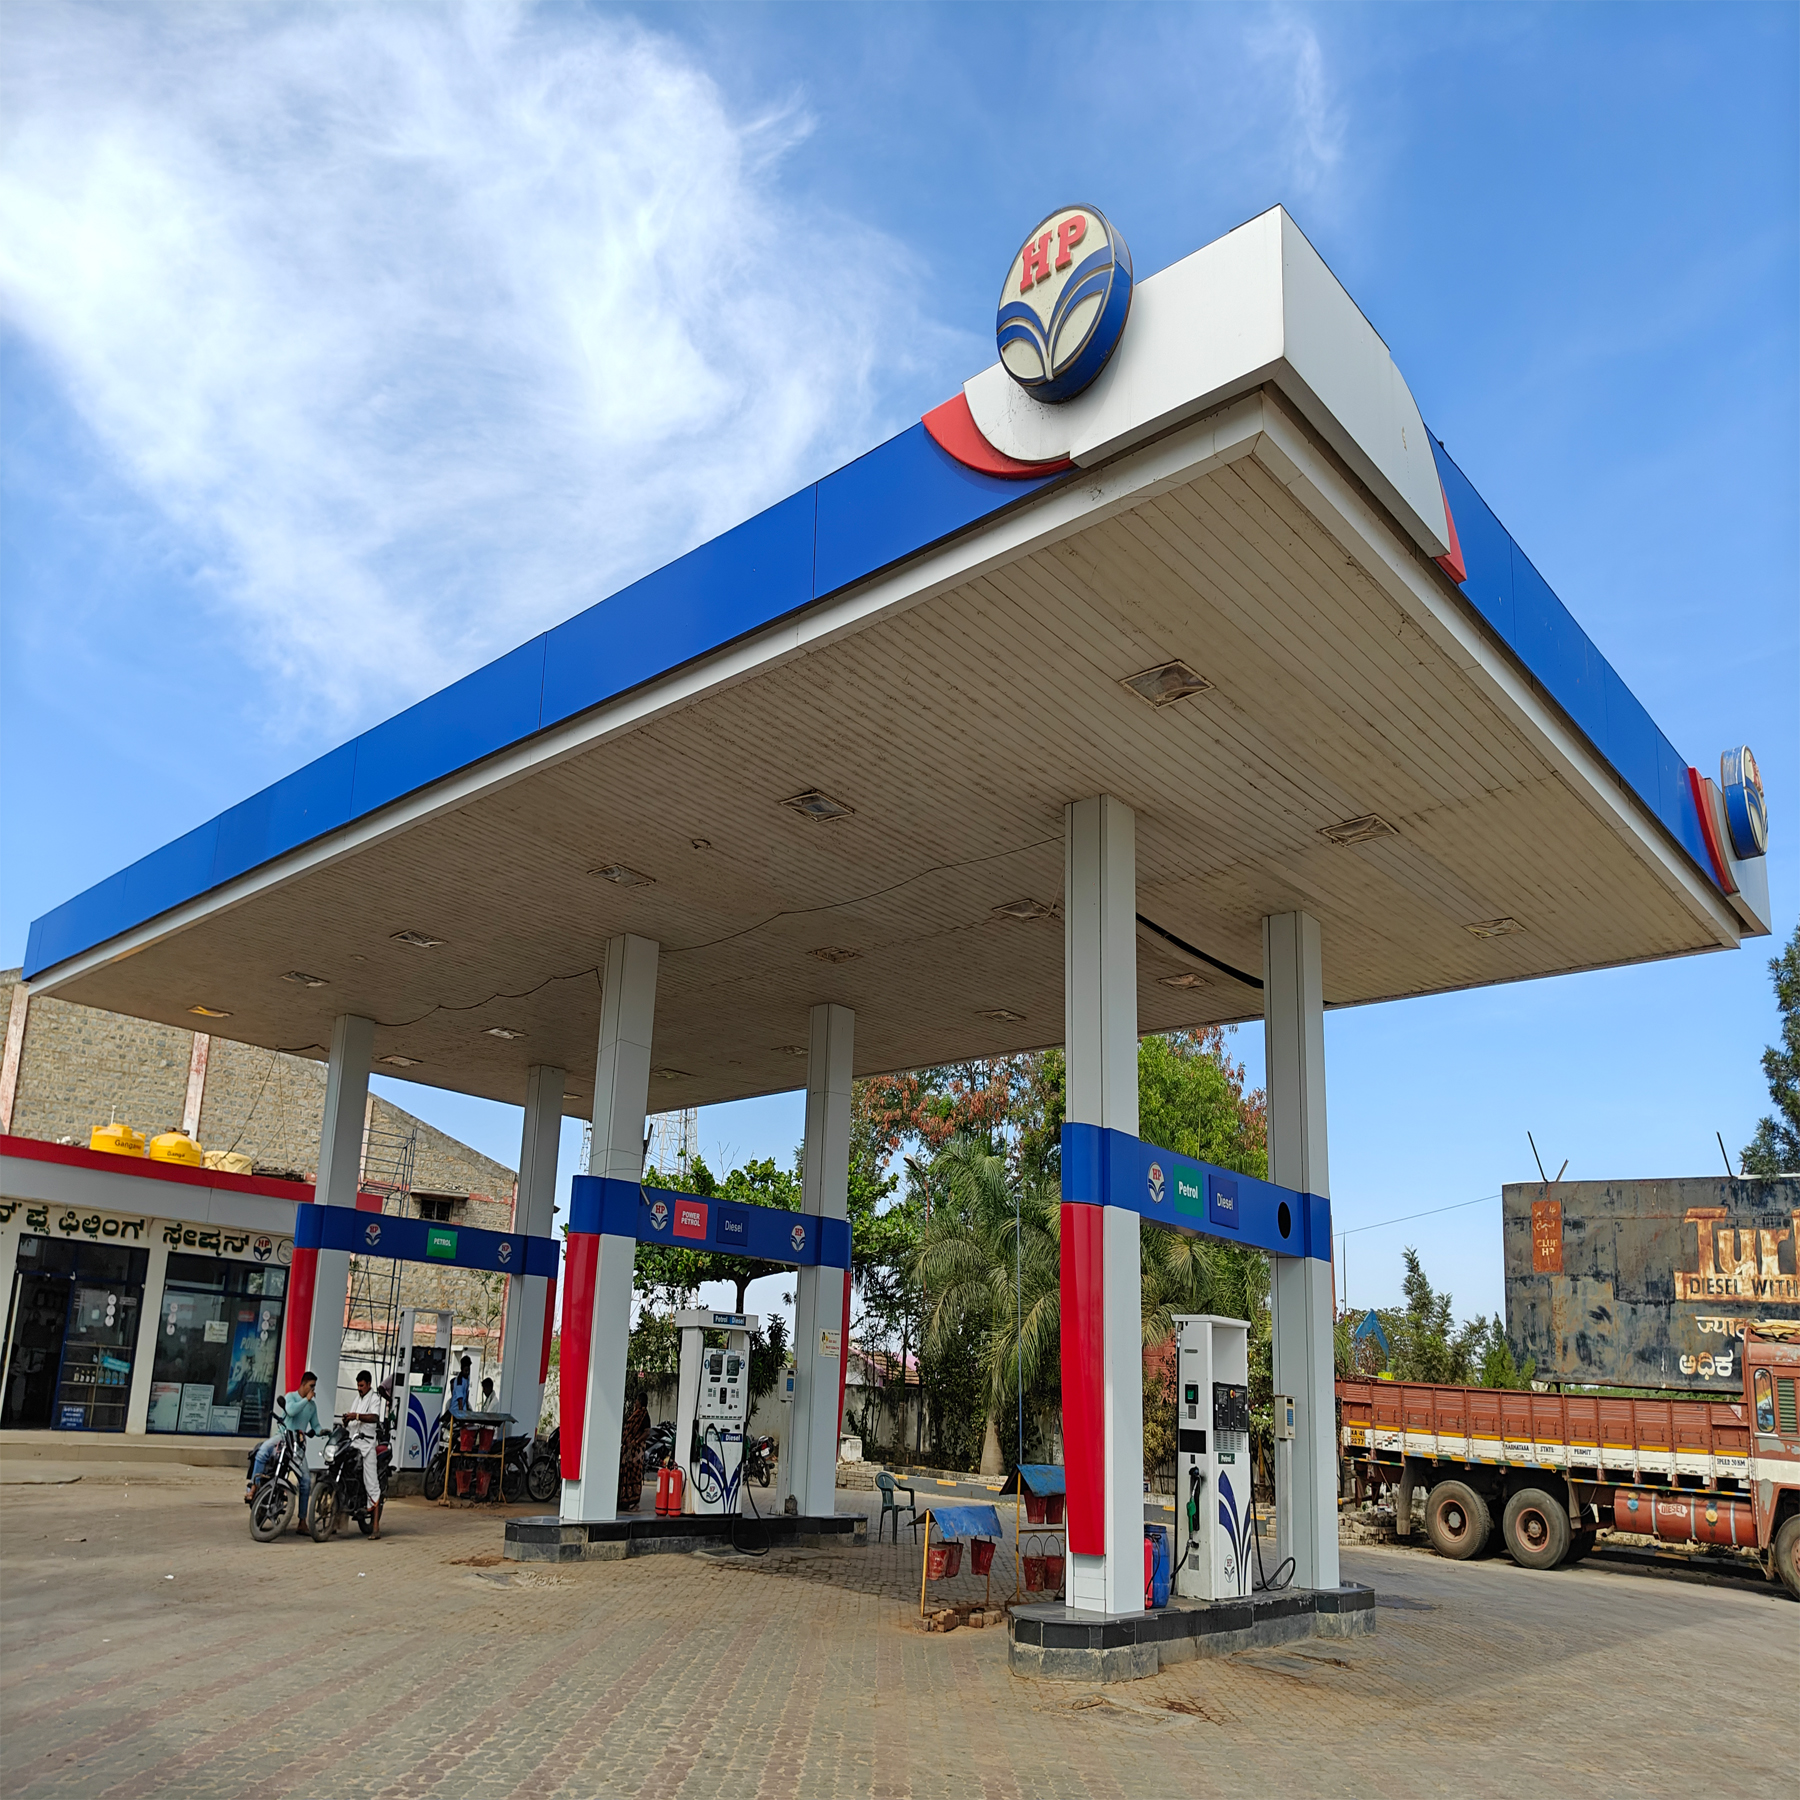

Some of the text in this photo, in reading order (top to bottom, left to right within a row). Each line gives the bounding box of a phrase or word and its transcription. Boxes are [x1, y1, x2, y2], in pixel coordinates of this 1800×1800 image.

[1019, 214, 1088, 294] HP
[114, 1139, 136, 1150] Ganga
[1152, 1168, 1162, 1181] HP
[1178, 1181, 1199, 1200] Petrol
[1216, 1192, 1234, 1211] Diesel
[655, 1204, 666, 1214] HP
[682, 1210, 701, 1220] POWER
[681, 1217, 701, 1227] PETROL
[724, 1220, 743, 1233] Diesel
[369, 1225, 379, 1233] HP
[794, 1228, 803, 1237] HP
[163, 1222, 250, 1256] ಸ್ಟೇಷನ್
[258, 1240, 269, 1248] HP
[433, 1237, 452, 1247] PETROL
[1689, 1277, 1799, 1297] DIESEL WITH
[731, 1316, 745, 1325] Diesel
[725, 1434, 741, 1442] Diesel
[1661, 1505, 1685, 1514] DIESEL
